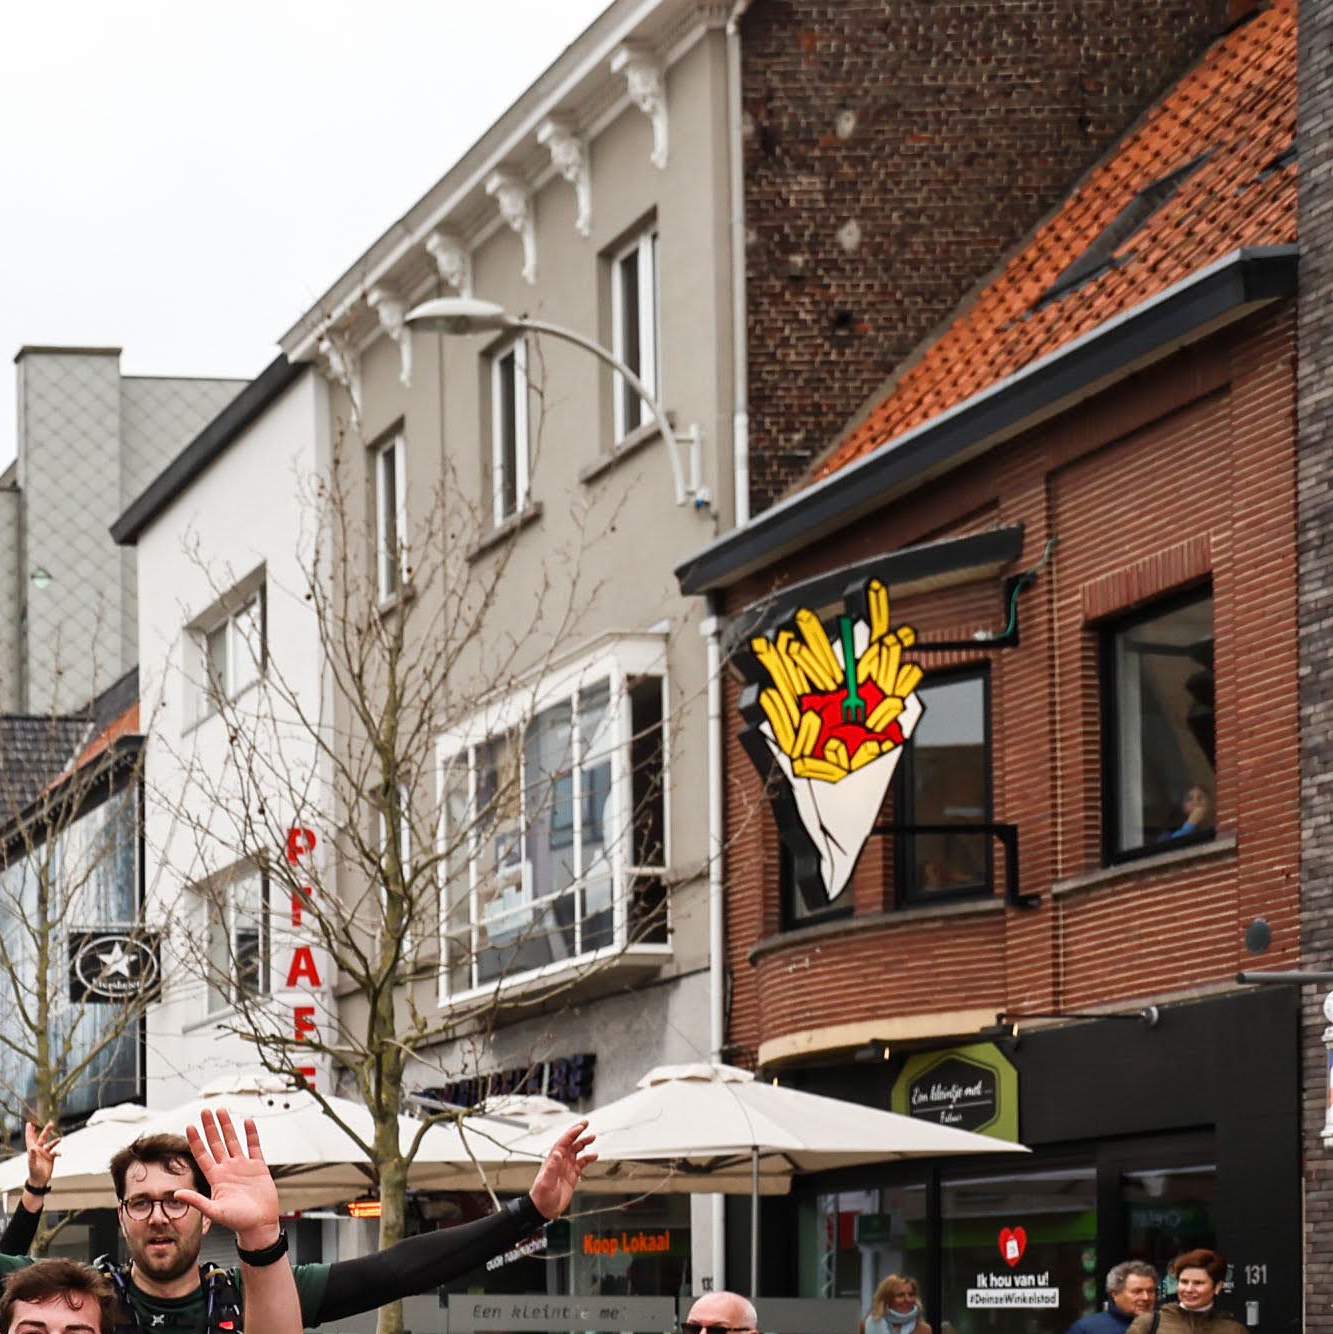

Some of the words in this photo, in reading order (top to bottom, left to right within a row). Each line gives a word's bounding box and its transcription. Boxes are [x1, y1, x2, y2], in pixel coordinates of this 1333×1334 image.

[584, 1234, 618, 1257] Koop
[622, 1230, 670, 1252] Lokaal
[976, 1272, 987, 1288] Ik
[989, 1272, 1012, 1287] hou
[1014, 1274, 1035, 1287] van
[1037, 1271, 1049, 1286] u!
[1244, 1264, 1268, 1285] 131
[473, 1307, 501, 1319] Een
